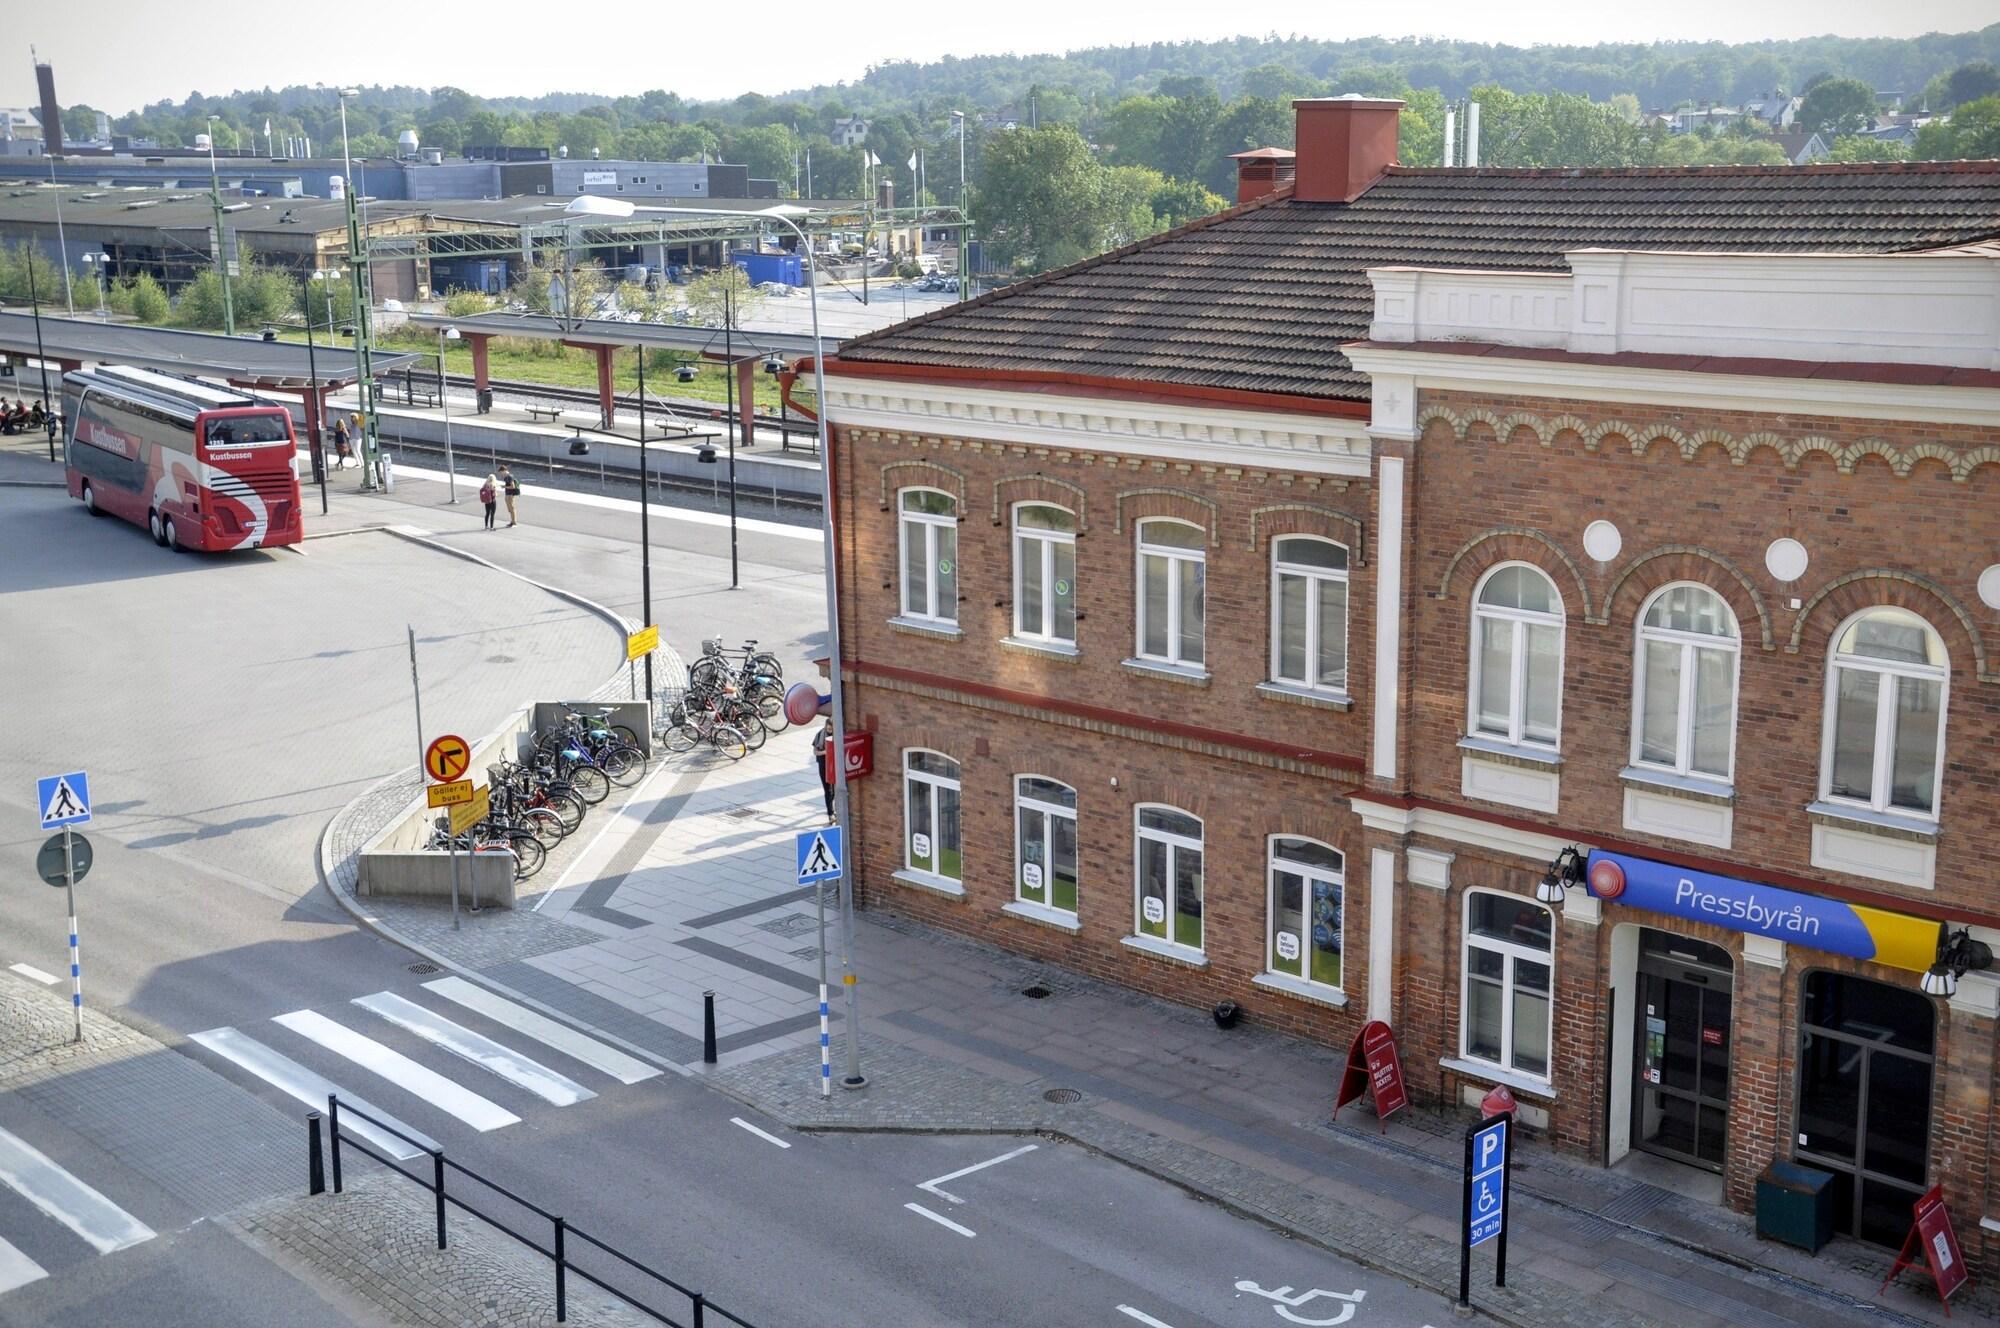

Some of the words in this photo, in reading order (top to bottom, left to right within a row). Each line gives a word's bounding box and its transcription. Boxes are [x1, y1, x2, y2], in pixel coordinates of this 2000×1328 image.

[210, 452, 252, 461] Kustbussen
[433, 786, 457, 795] Gäller
[460, 783, 468, 791] ej
[1675, 878, 1820, 935] Pressbyrån
[1376, 1074, 1392, 1088] TICKETS
[1481, 1133, 1498, 1168] P
[1472, 1227, 1482, 1240] 30
[1485, 1220, 1500, 1233] min
